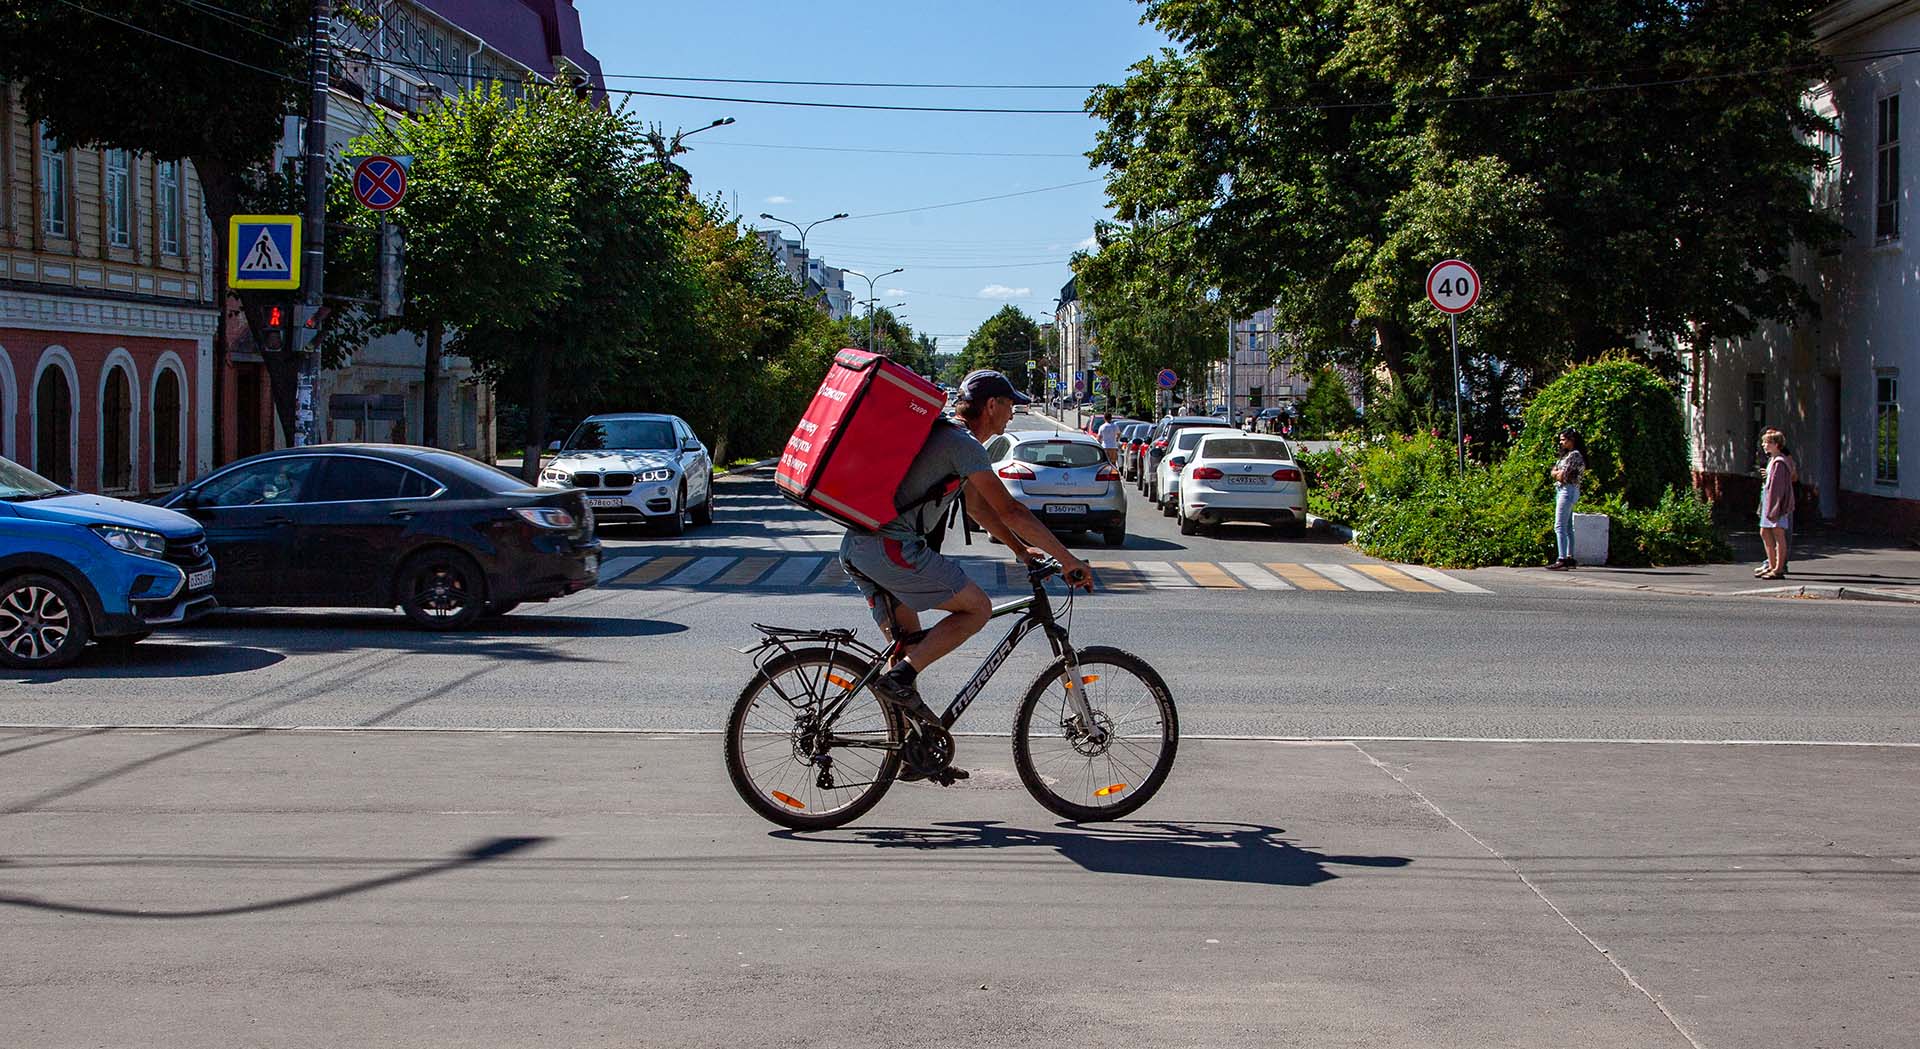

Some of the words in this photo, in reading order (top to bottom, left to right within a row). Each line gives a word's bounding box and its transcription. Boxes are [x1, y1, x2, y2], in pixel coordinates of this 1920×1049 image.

[1438, 277, 1469, 297] 40
[909, 402, 928, 415] 72699
[951, 641, 1012, 718] MERIDA
